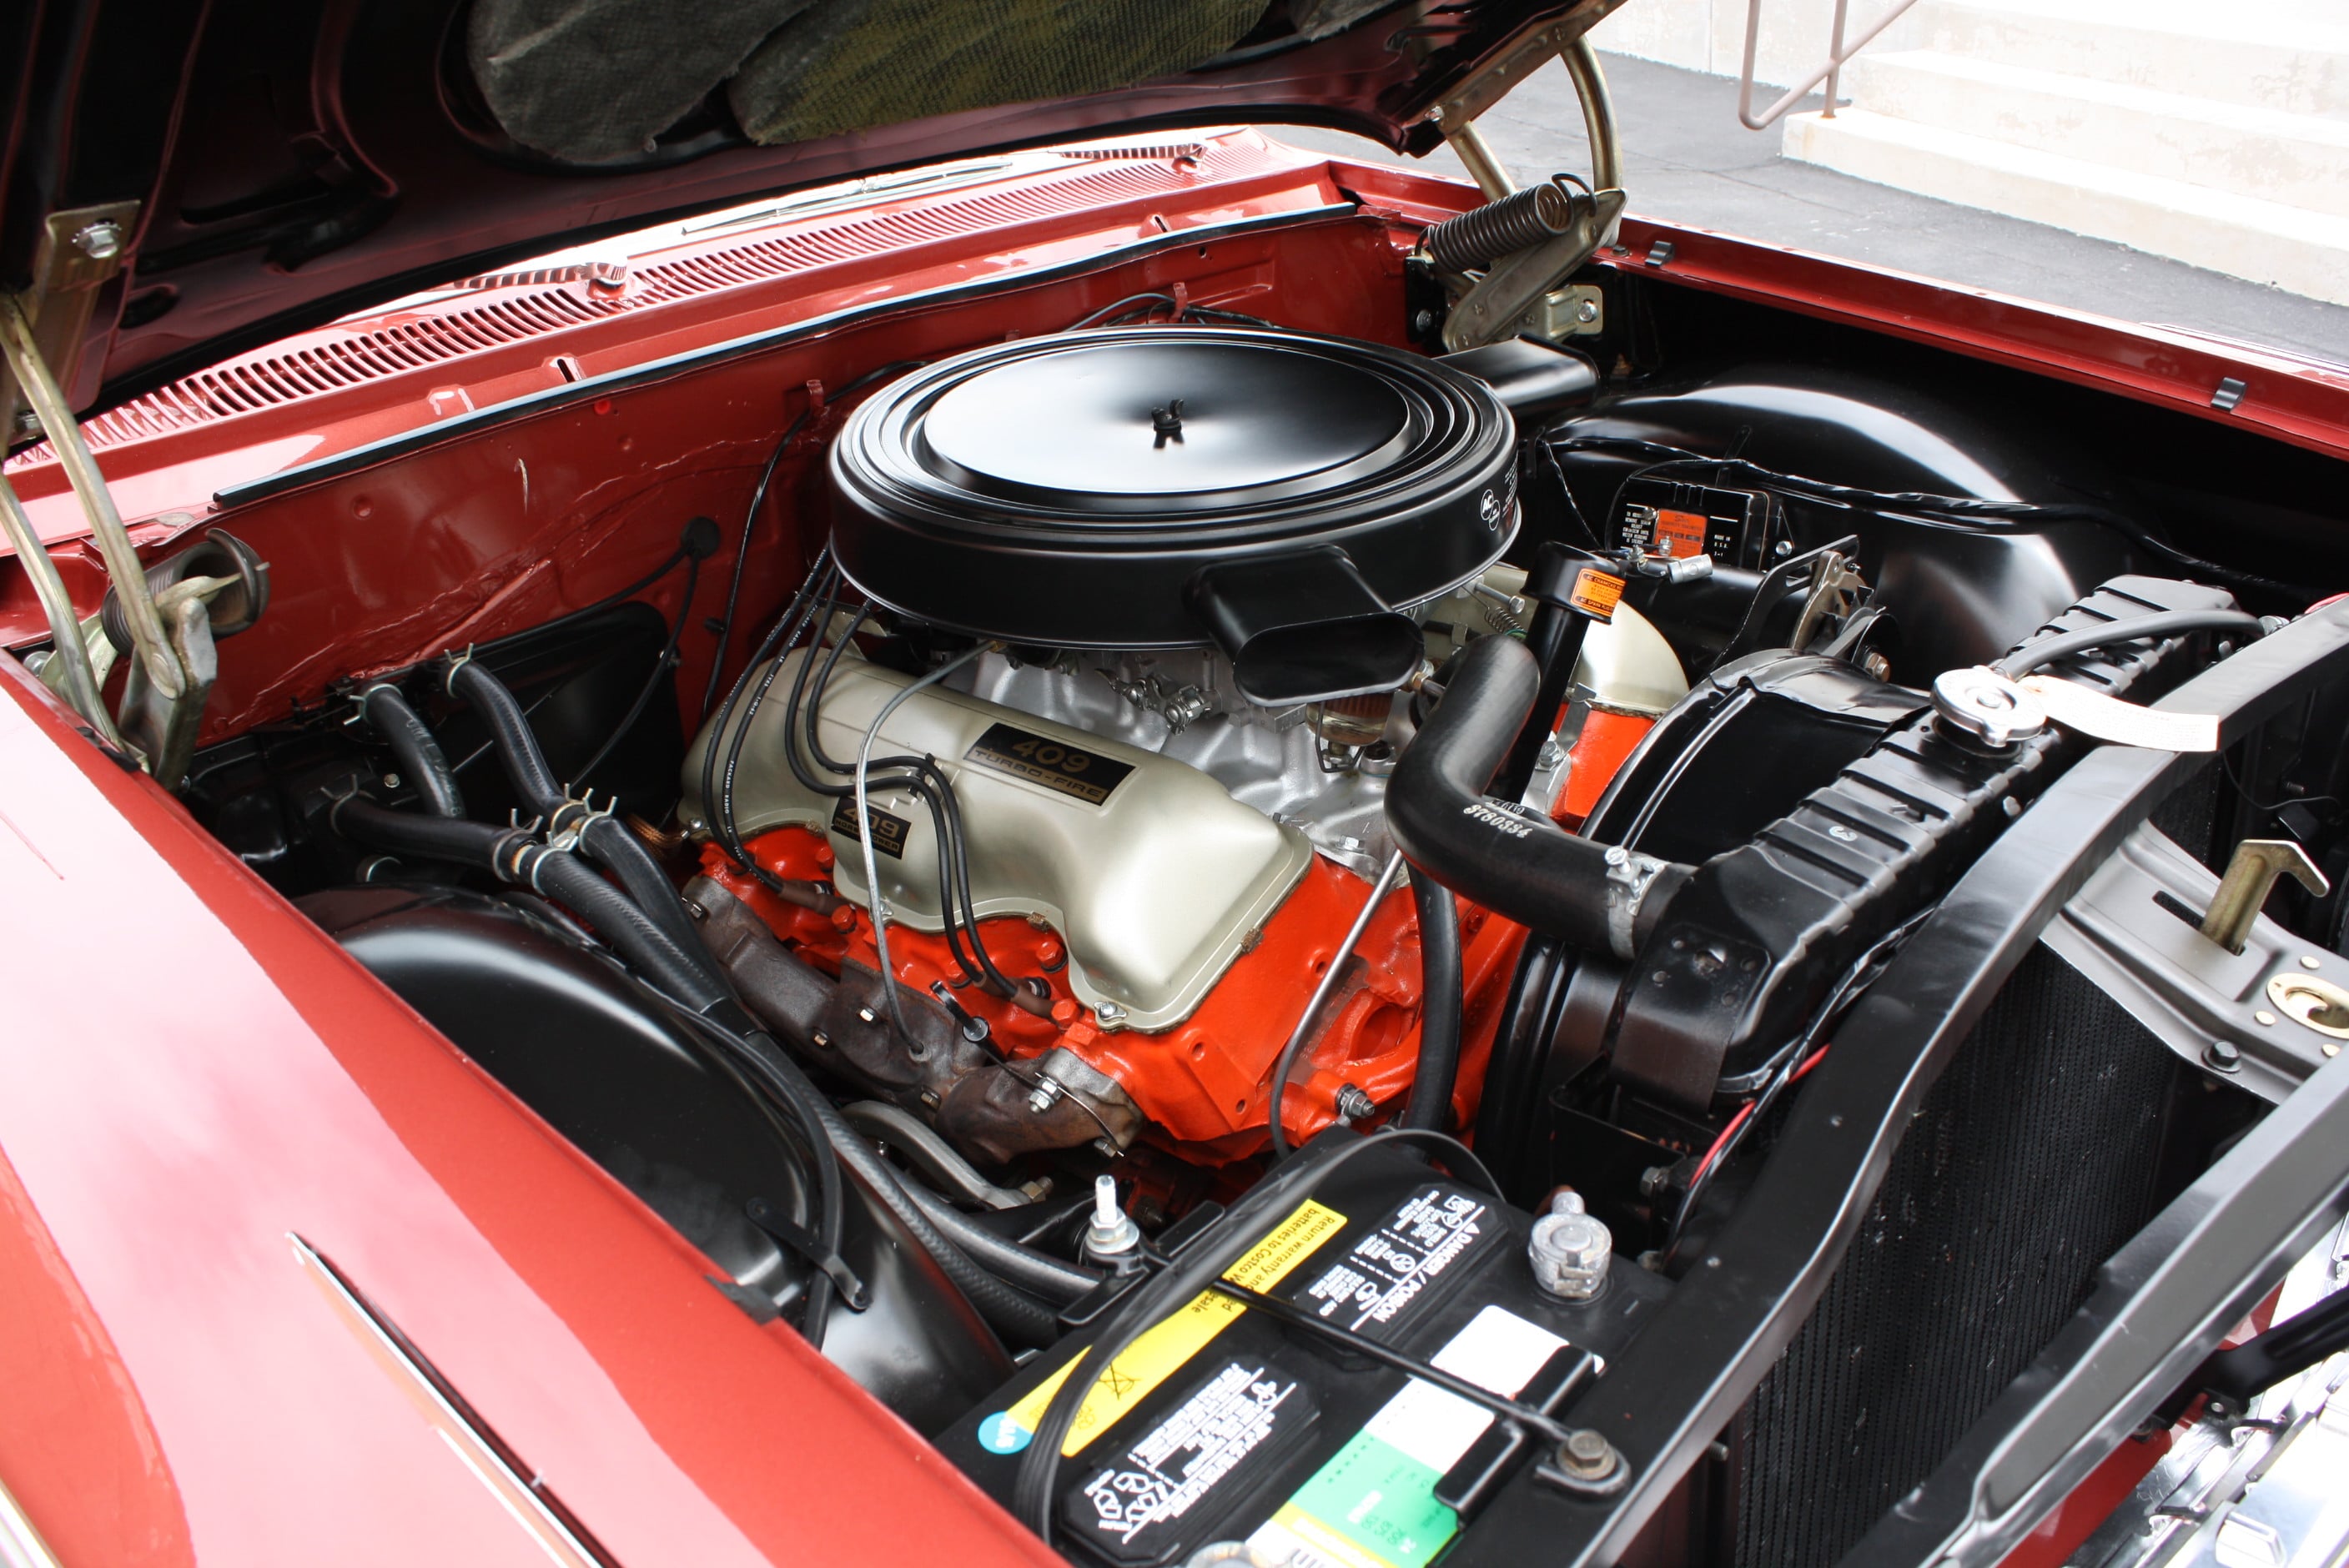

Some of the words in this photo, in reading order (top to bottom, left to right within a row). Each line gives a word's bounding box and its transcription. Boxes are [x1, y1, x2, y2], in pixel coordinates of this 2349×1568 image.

[1482, 495, 1492, 514] AC
[1012, 740, 1091, 773] 409
[725, 760, 735, 789] PACKARD
[1276, 1207, 1320, 1240] batteries
[1300, 1214, 1335, 1243] Return
[1260, 1240, 1303, 1276] warranty
[1266, 1239, 1279, 1249] to
[1421, 1230, 1472, 1277] DANGER
[1238, 1247, 1272, 1274] Costco
[1371, 1277, 1421, 1324] POISON
